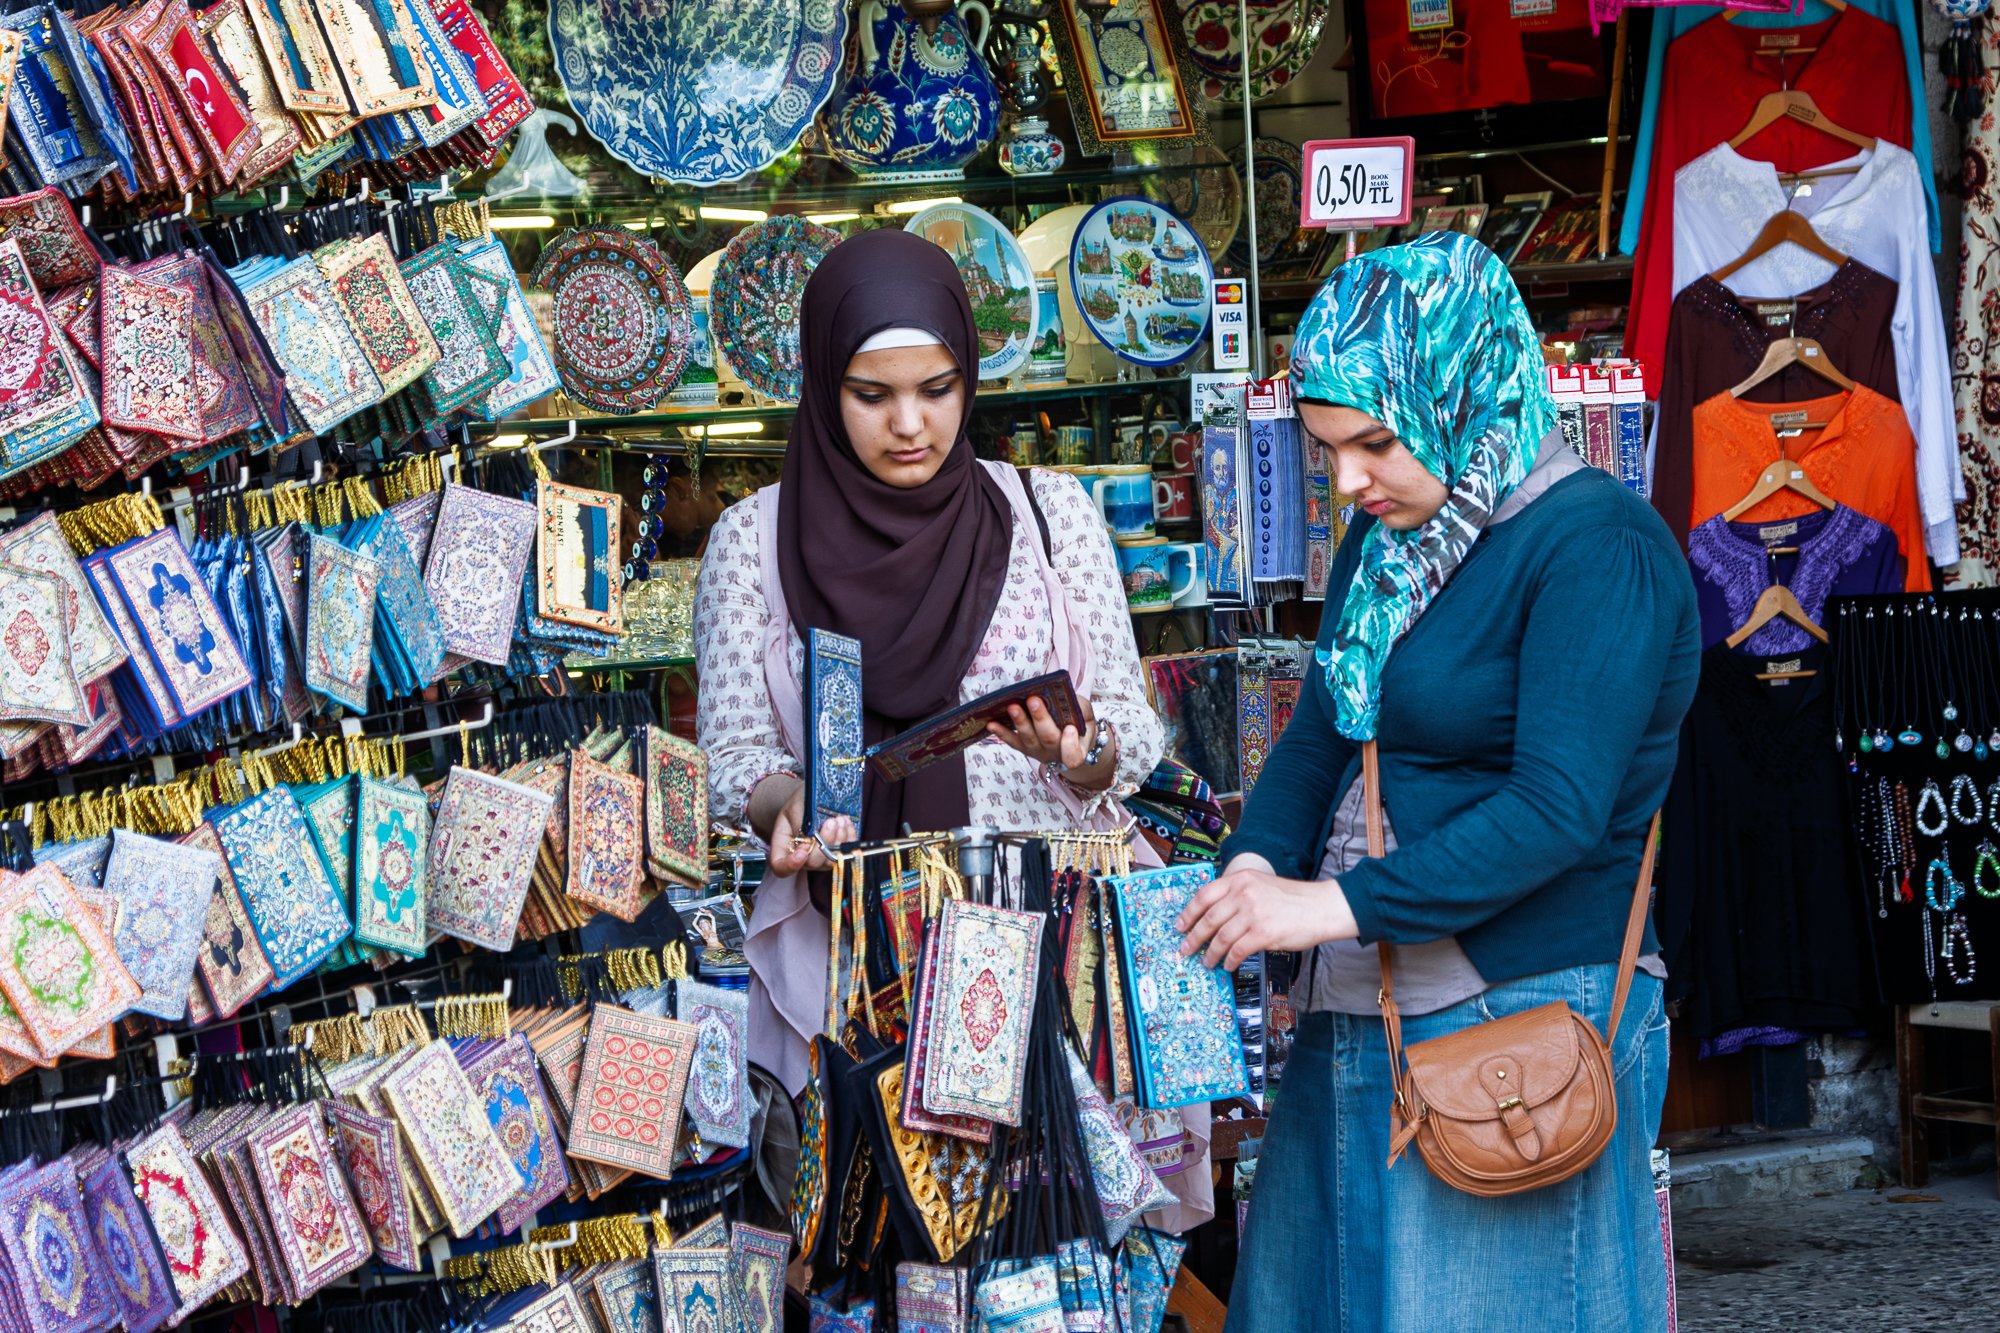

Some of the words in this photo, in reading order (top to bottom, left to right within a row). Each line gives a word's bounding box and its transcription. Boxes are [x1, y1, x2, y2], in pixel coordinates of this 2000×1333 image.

[469, 23, 503, 76] ISTANBUL
[15, 63, 48, 136] ISTANBUL
[1316, 163, 1367, 214] 0,50
[1368, 186, 1394, 204] TL
[1219, 312, 1242, 323] VISA
[980, 345, 1017, 371] MOSQUE
[1253, 430, 1274, 442] Turkey
